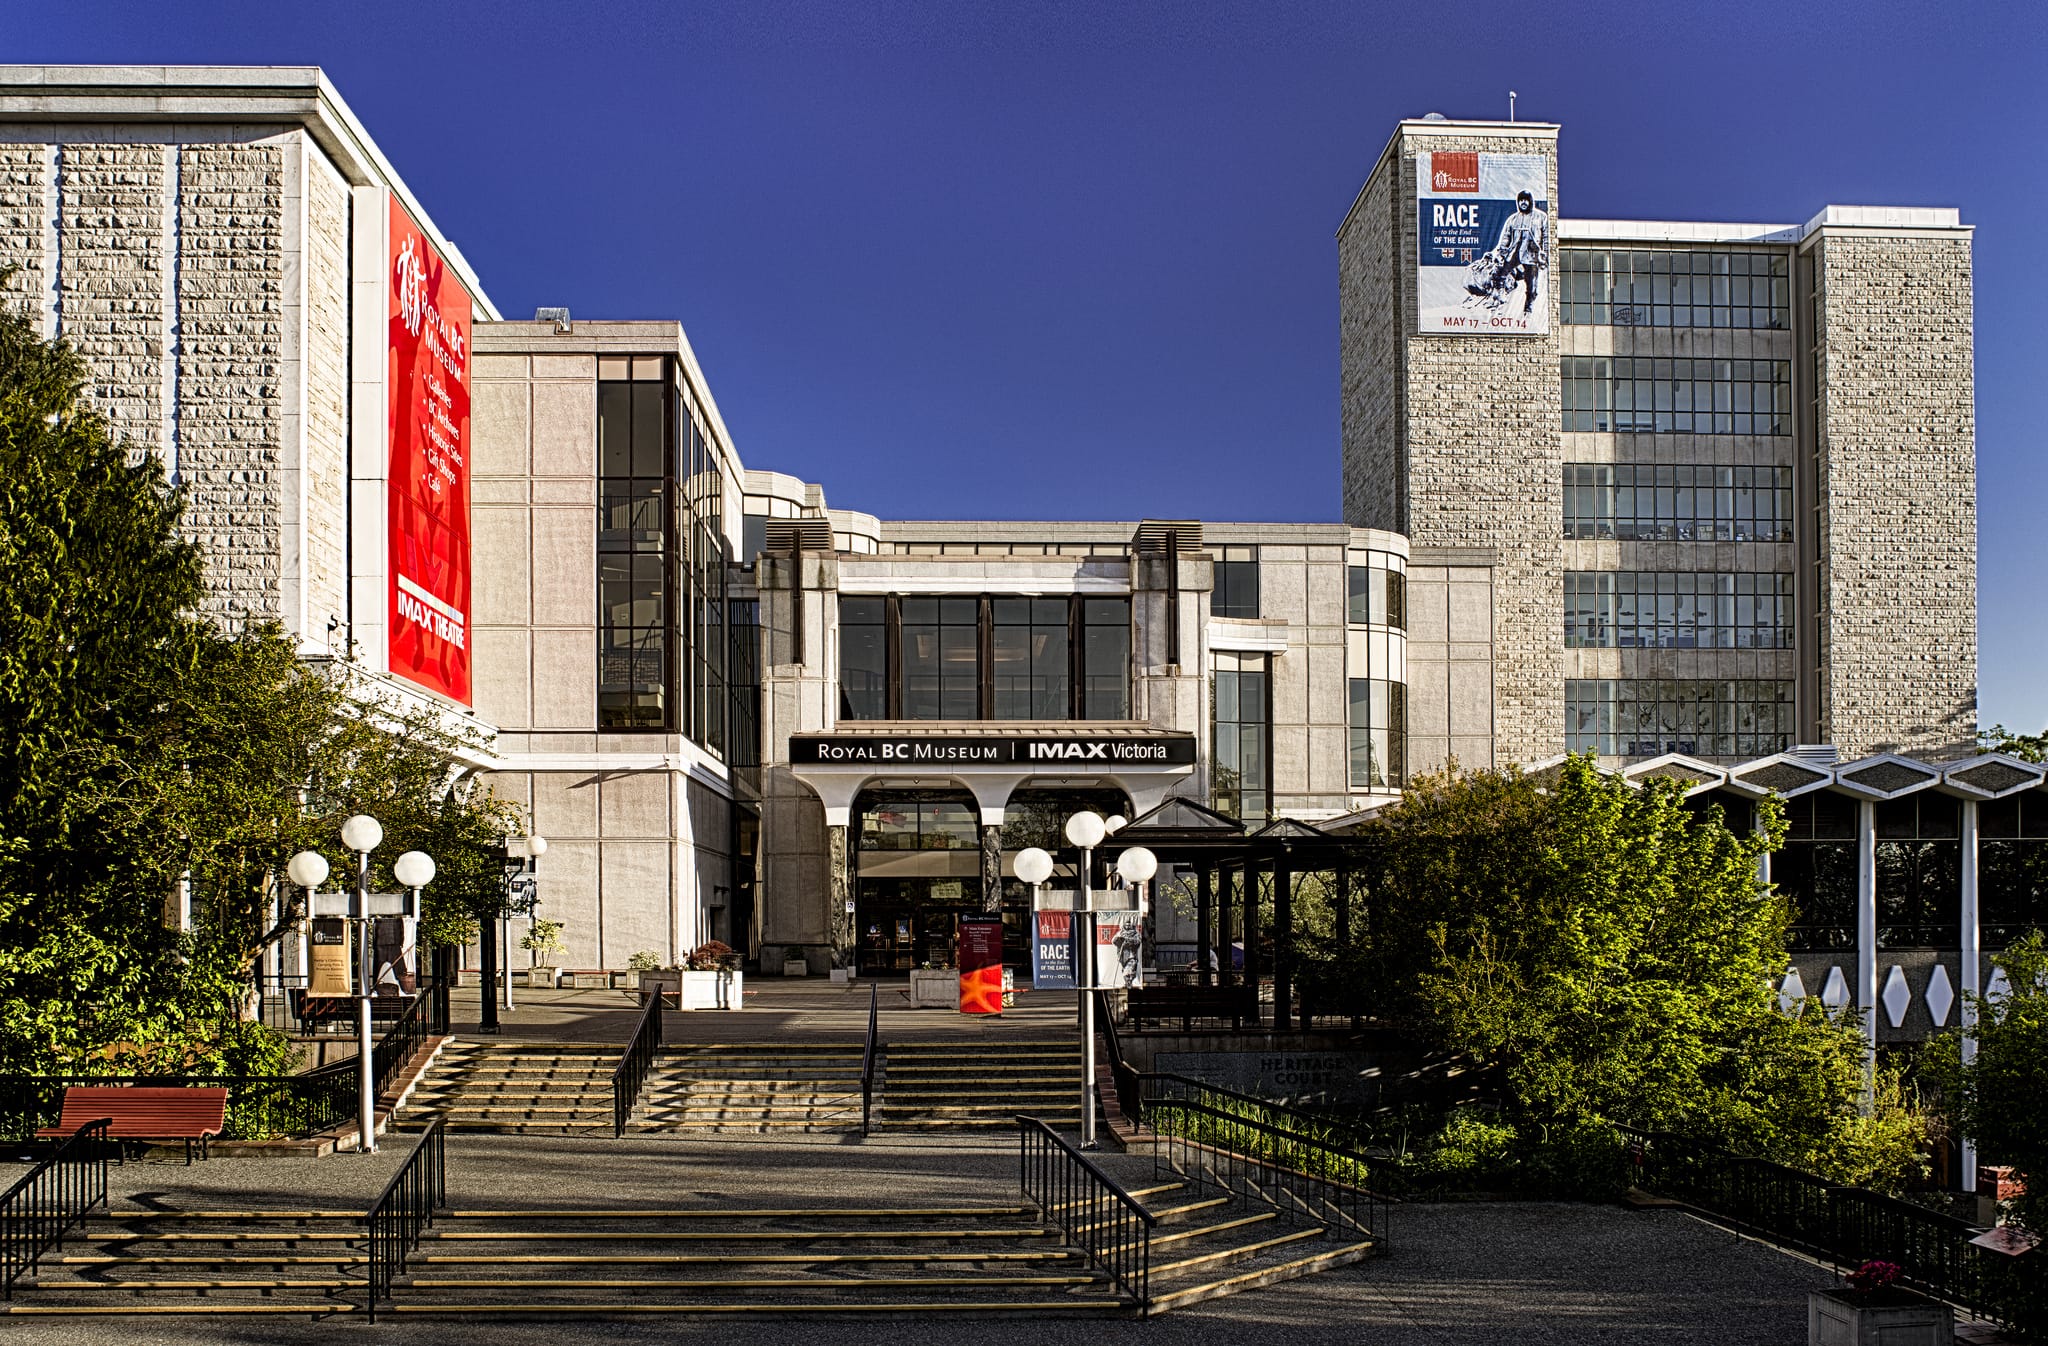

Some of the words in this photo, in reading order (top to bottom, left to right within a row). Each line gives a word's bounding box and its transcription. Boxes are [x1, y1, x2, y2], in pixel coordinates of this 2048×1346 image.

[1433, 204, 1479, 227] RACE
[422, 290, 450, 344] ROYAL
[452, 326, 464, 360] BC
[1443, 317, 1465, 327] MAY
[1469, 319, 1479, 329] 17
[1491, 317, 1513, 327] OCT
[1516, 319, 1527, 329] 14
[425, 323, 461, 382] MUSEUM
[428, 374, 452, 408] Galleries
[429, 398, 437, 418] BC
[438, 407, 459, 441] Archives
[428, 422, 450, 455] Historic
[451, 444, 463, 467] Sites
[428, 448, 439, 469] Gift
[440, 458, 456, 485] Shops
[428, 473, 440, 495] Café
[398, 590, 433, 633] IMAX
[434, 612, 465, 650] THEATRE
[818, 743, 877, 759] ROYAL
[882, 743, 909, 759] BC
[915, 743, 997, 759] MUSEUM
[1029, 743, 1107, 759] IMAX
[1112, 743, 1167, 759] Victoria
[1040, 944, 1070, 960] RACE
[1261, 1058, 1346, 1072] HERITAGE
[1275, 1073, 1333, 1085] COURT
